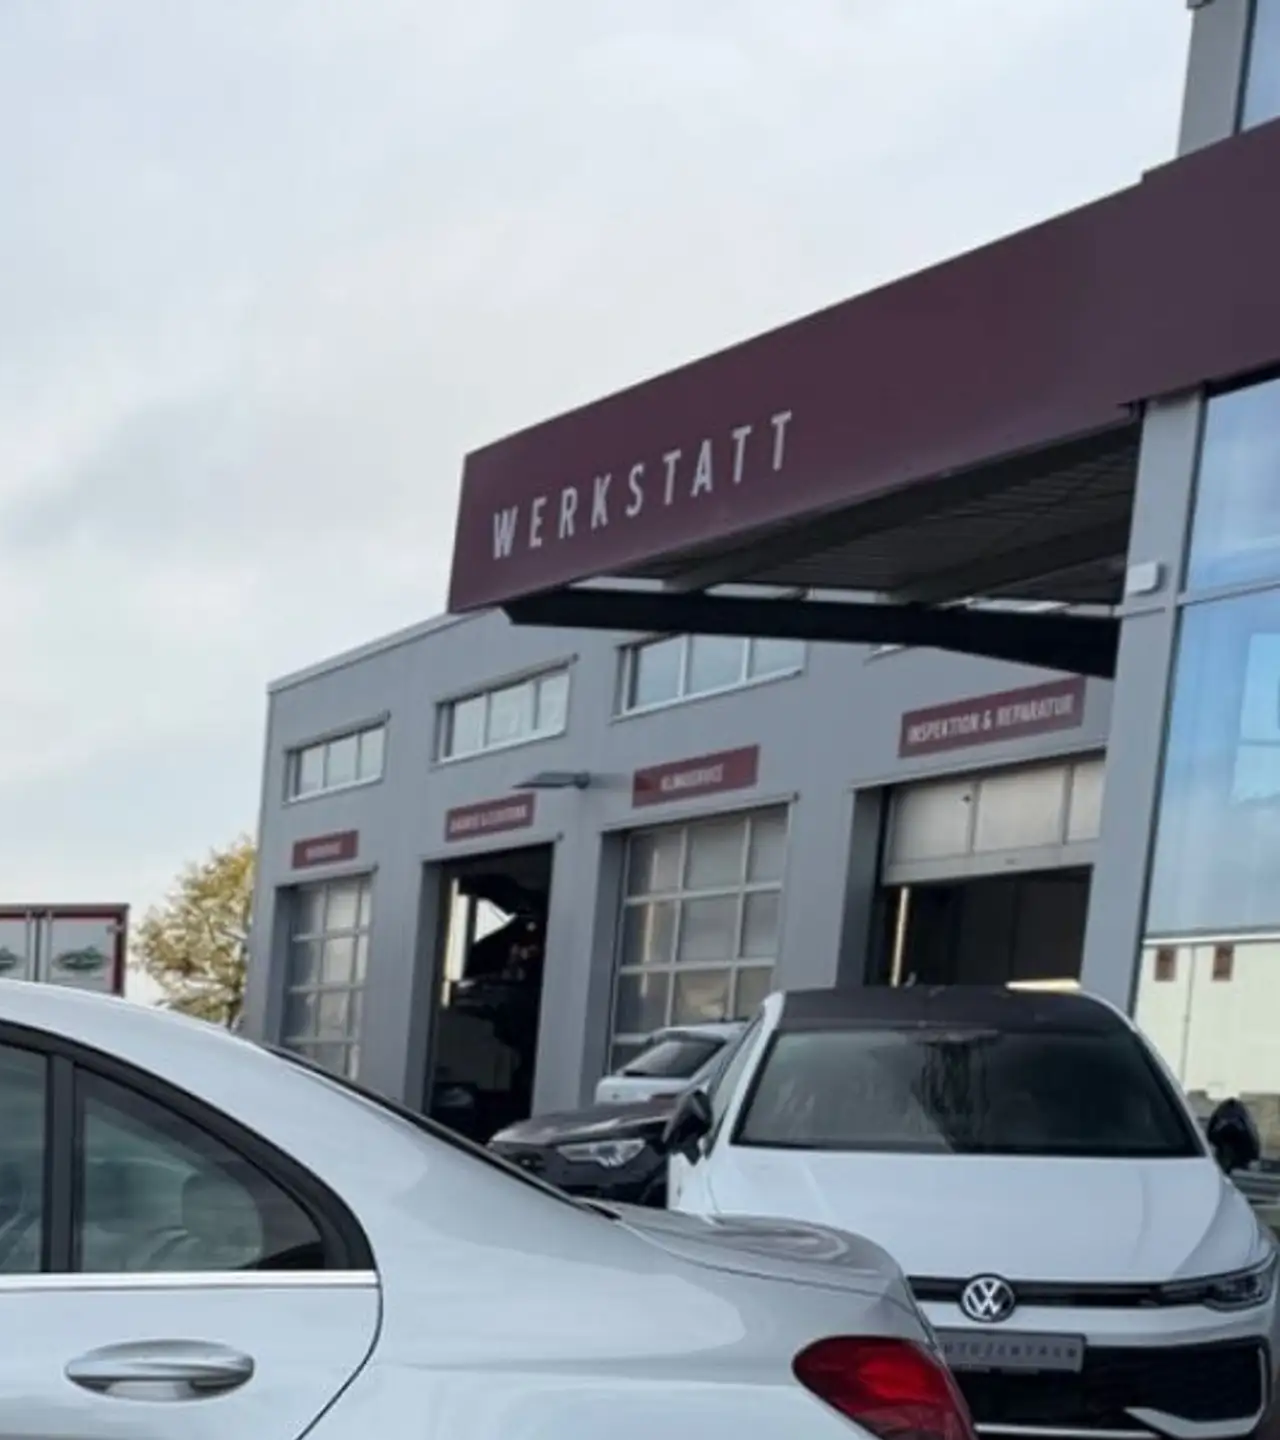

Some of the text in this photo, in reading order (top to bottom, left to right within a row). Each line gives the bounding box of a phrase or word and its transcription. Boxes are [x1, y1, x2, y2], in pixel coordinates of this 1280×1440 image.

[493, 410, 792, 560] WERKSTATT
[906, 712, 980, 745] INSPEKTION
[995, 693, 1075, 727] REPARATUR
